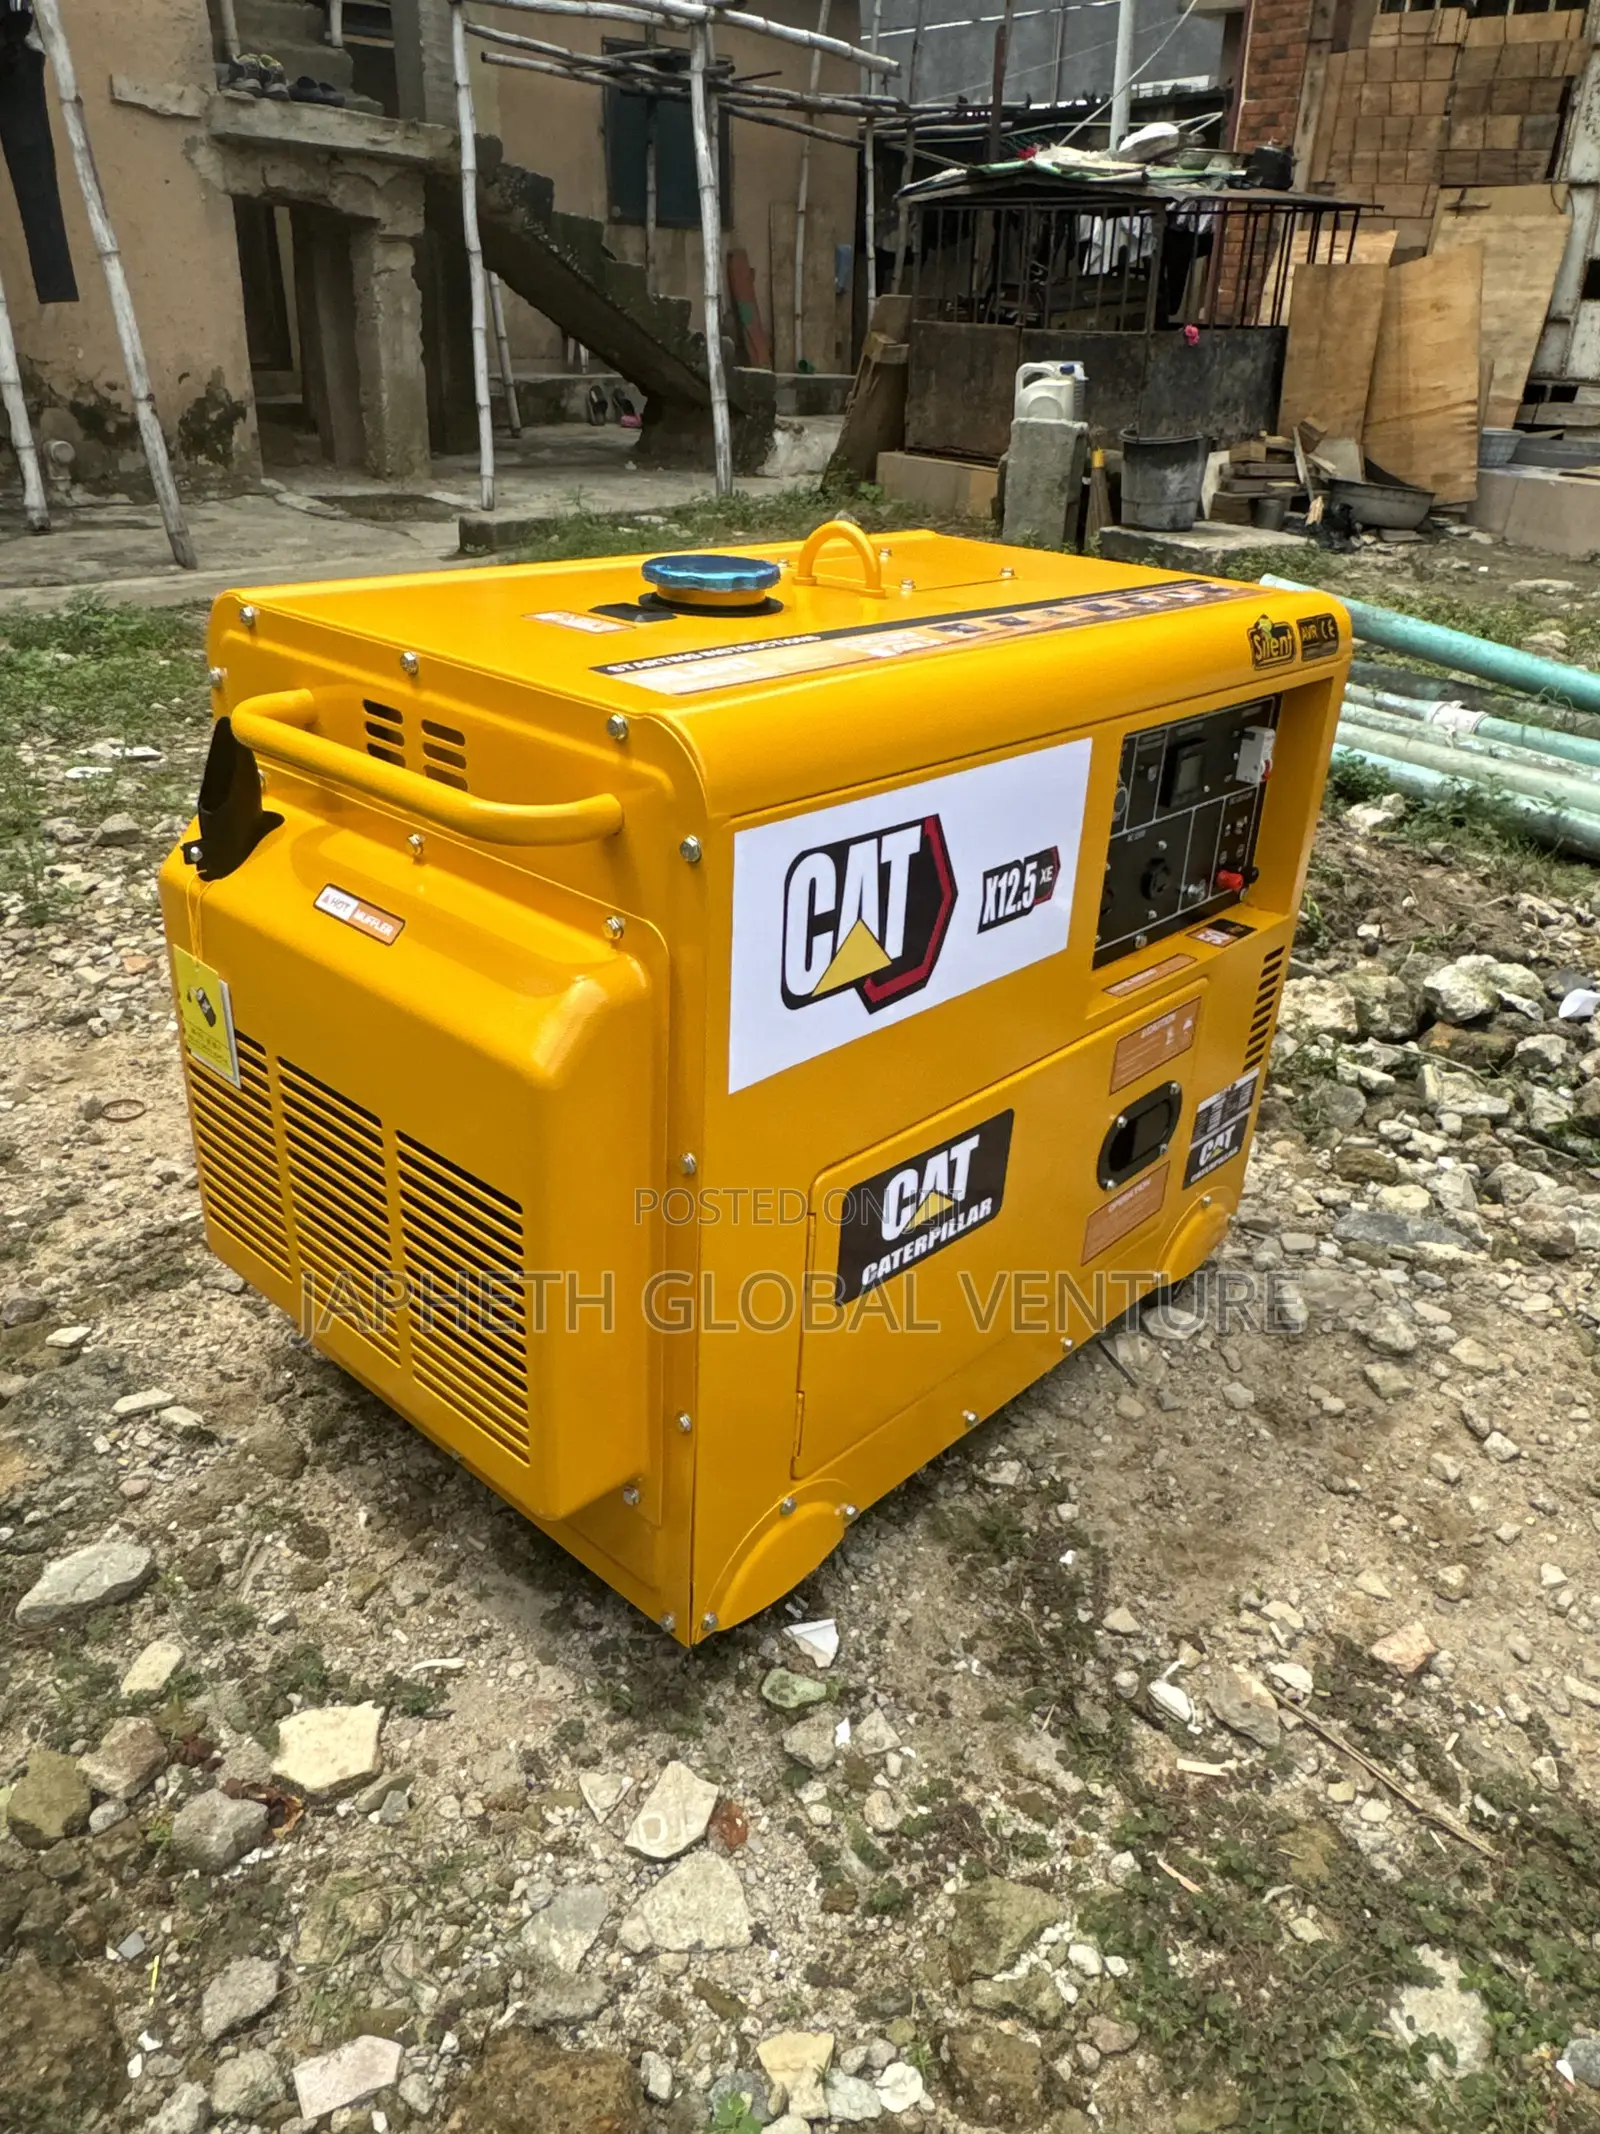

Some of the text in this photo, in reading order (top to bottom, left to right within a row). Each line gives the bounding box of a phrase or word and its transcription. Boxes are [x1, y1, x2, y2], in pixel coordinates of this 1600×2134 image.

[1253, 629, 1293, 661] Silent
[330, 896, 394, 937] HOT MUFFLER
[784, 824, 922, 996] CAT
[982, 862, 1039, 926] X12.5
[1199, 1124, 1237, 1168] CAT
[881, 1133, 981, 1242] CAT
[861, 1197, 993, 1286] CATERPILLAR
